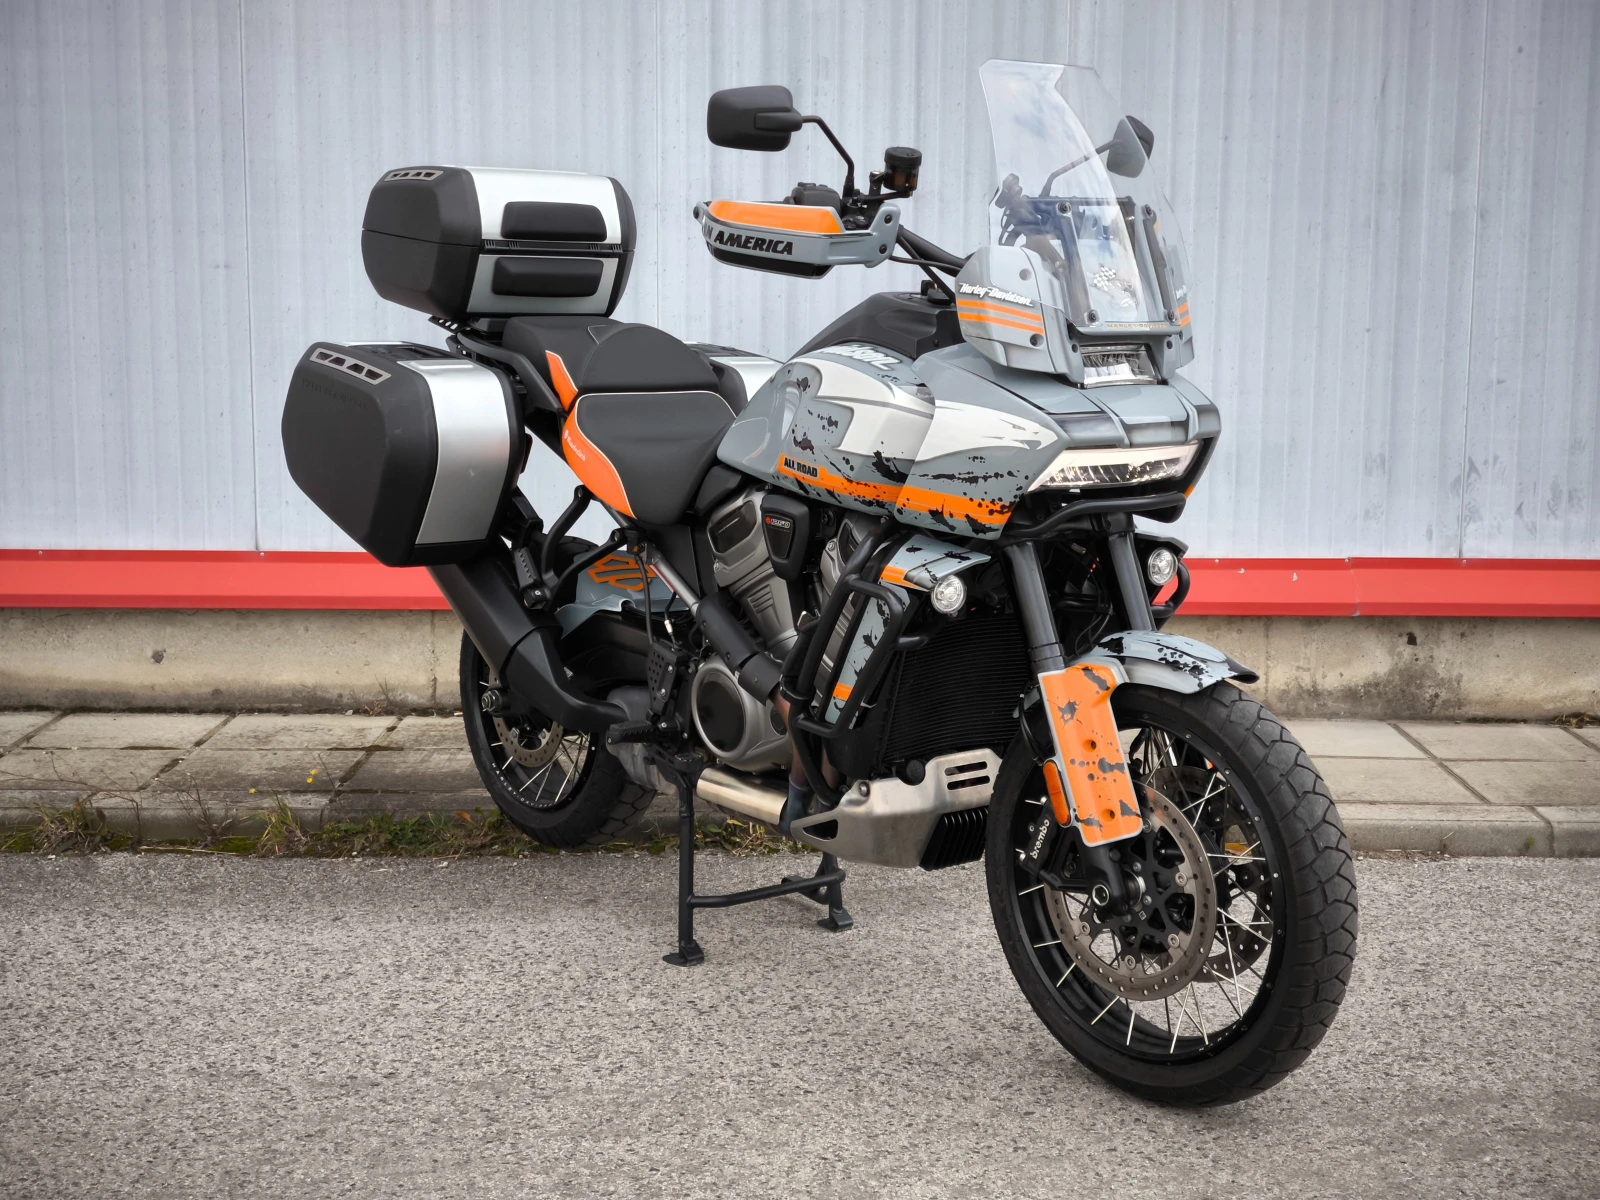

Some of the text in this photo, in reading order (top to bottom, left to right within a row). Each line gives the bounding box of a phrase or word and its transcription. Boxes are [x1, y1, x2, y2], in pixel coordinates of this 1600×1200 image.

[714, 230, 794, 255] AMERICA
[959, 282, 1034, 306] Harley-Davidson
[784, 457, 818, 478] ALL ROAD
[1029, 819, 1050, 860] brembo
